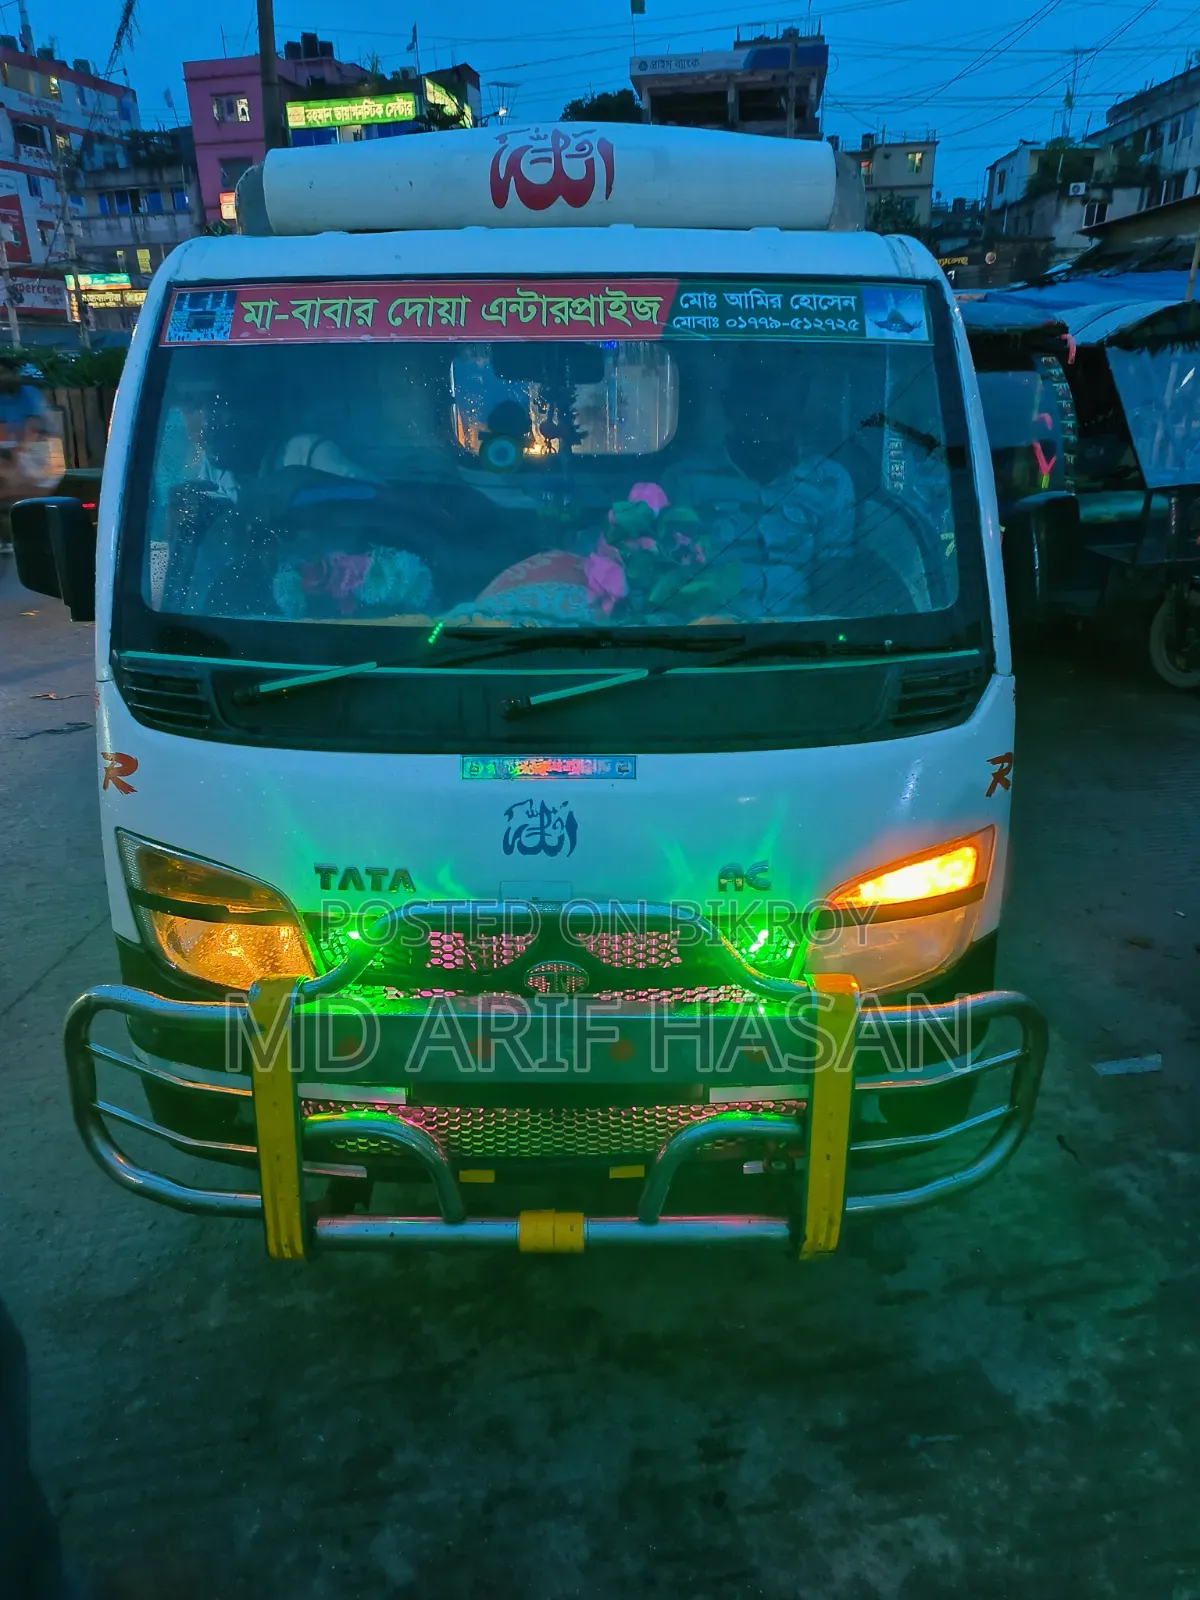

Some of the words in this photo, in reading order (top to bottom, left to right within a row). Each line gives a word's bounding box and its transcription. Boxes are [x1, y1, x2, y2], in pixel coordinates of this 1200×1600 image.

[240, 296, 379, 330] মা-বাবার
[387, 295, 472, 328] দোয়া
[481, 287, 664, 328] এন্টারপ্রাইজ
[680, 292, 717, 309] মোঃ
[723, 288, 783, 310] আমির
[790, 293, 857, 312] হোসেন
[672, 315, 720, 329] মোবাঃ
[725, 316, 860, 333] ০১৭৭৯-৫১২৭২৫
[314, 862, 416, 893] TATA
